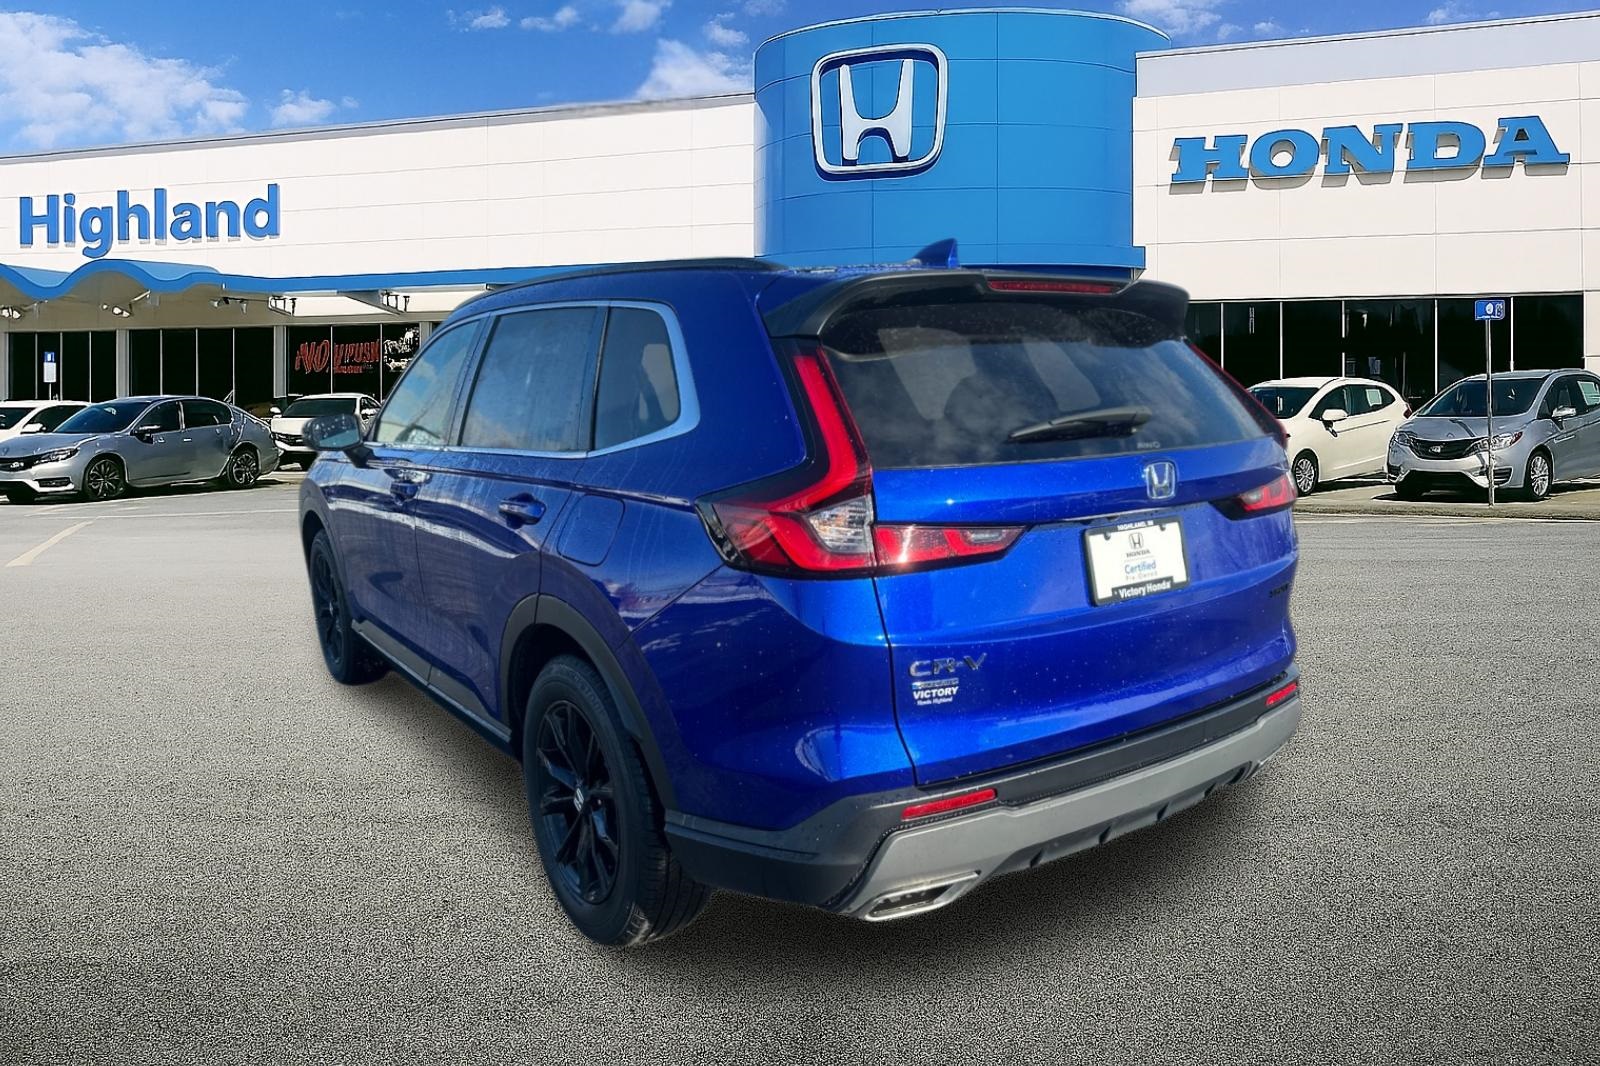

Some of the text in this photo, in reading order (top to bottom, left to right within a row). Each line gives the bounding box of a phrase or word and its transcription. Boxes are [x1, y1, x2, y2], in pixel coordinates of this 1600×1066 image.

[1170, 115, 1571, 185] HONDA
[19, 183, 281, 258] Highland
[1126, 549, 1151, 558] HONDA
[1124, 560, 1157, 574] Certified
[1118, 580, 1171, 598] Victory Honda
[909, 652, 987, 677] CR-V
[913, 686, 959, 700] VICTORY
